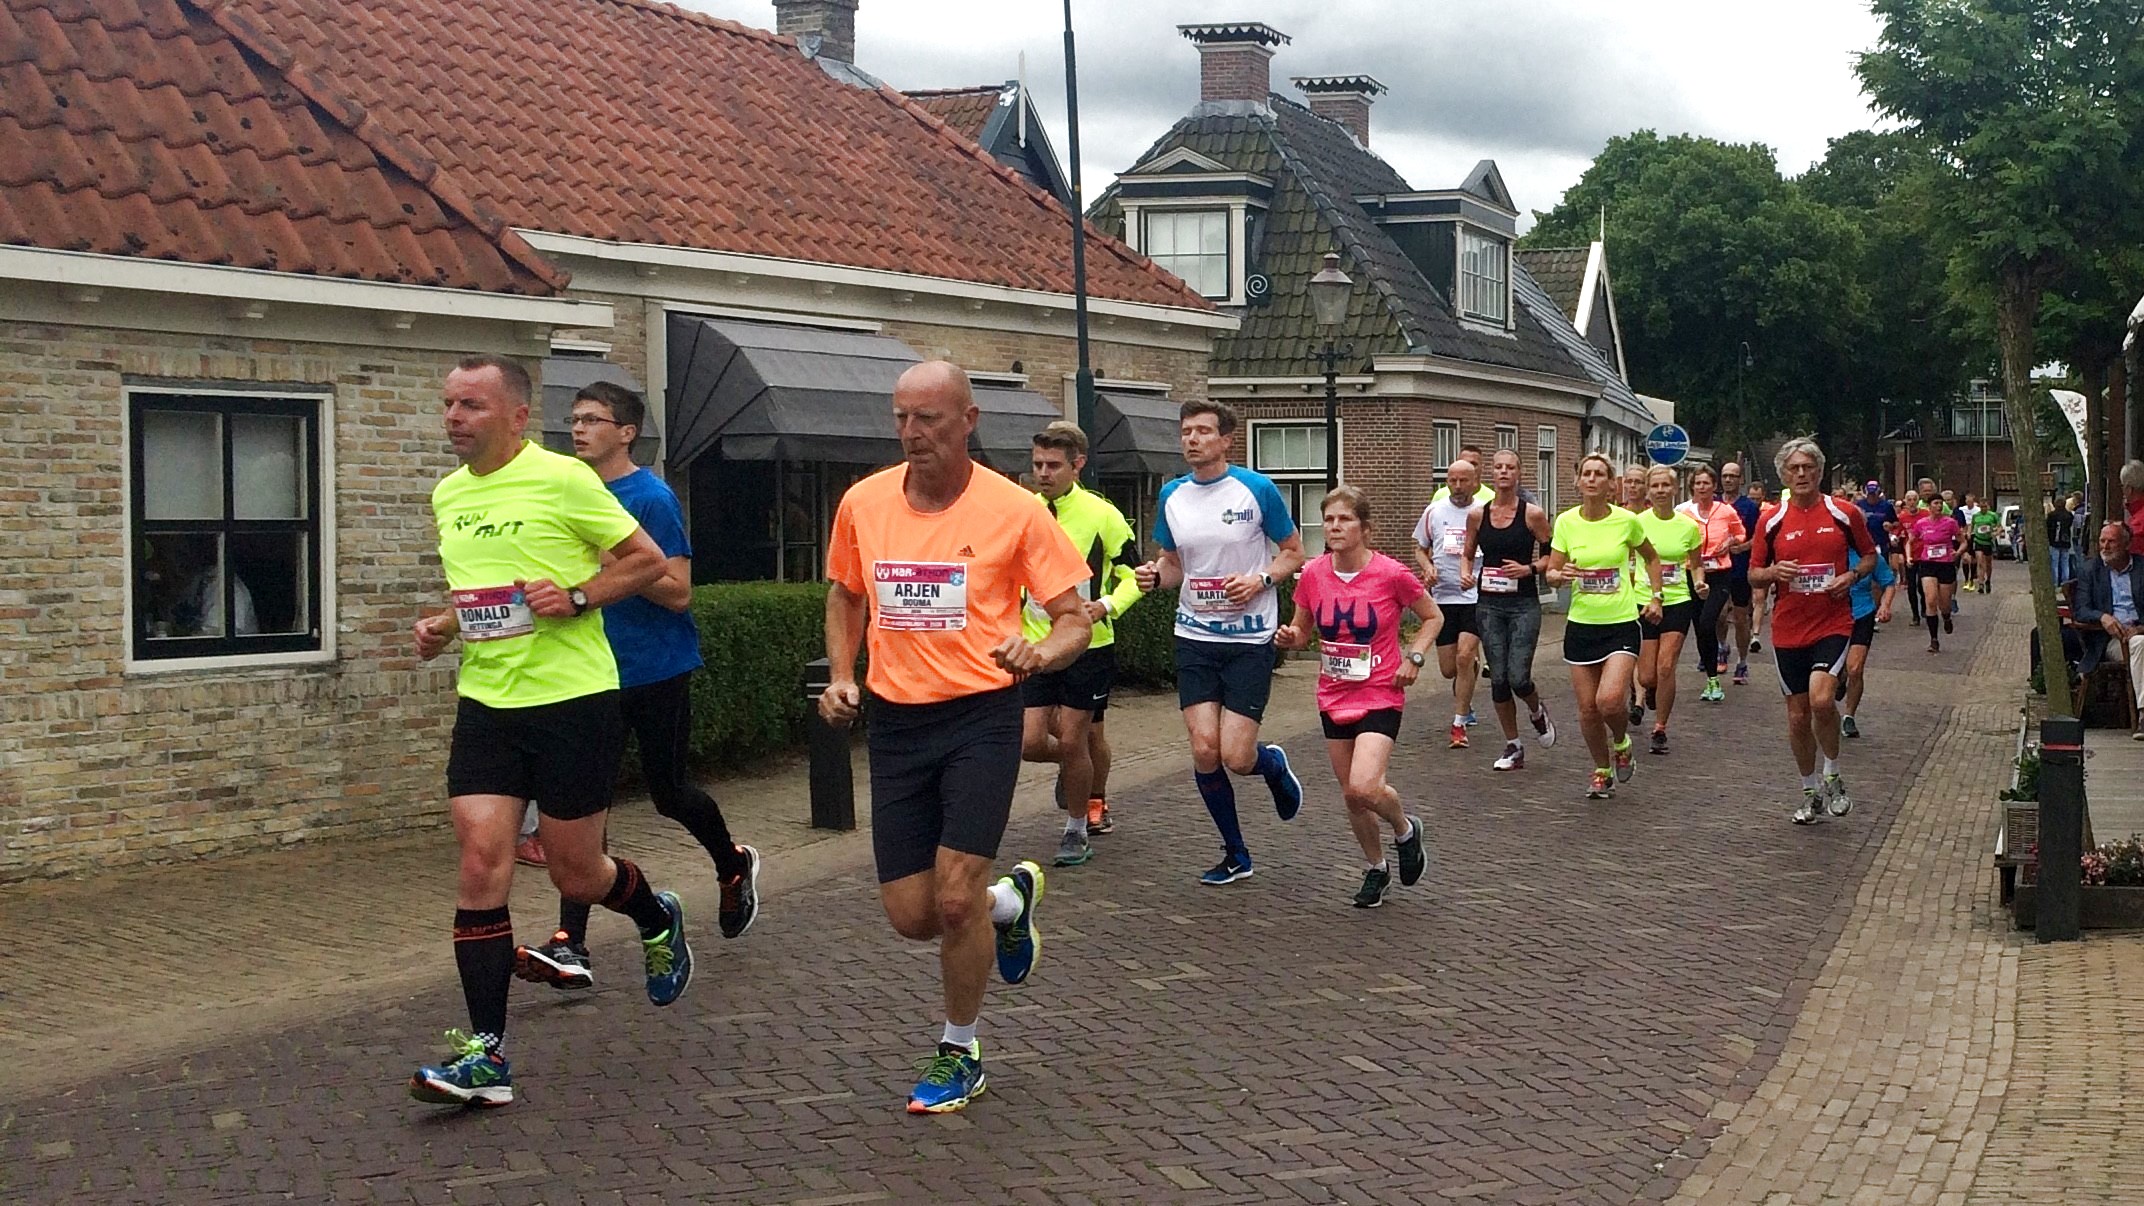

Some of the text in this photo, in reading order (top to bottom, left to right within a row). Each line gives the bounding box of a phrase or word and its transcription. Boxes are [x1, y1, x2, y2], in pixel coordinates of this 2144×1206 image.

[452, 511, 488, 531] RUN
[473, 521, 524, 539] FAST
[895, 583, 940, 598] ARJEN
[1196, 590, 1227, 600] MARTI
[461, 605, 511, 622] RONALD
[1328, 656, 1352, 668] SOFIA
